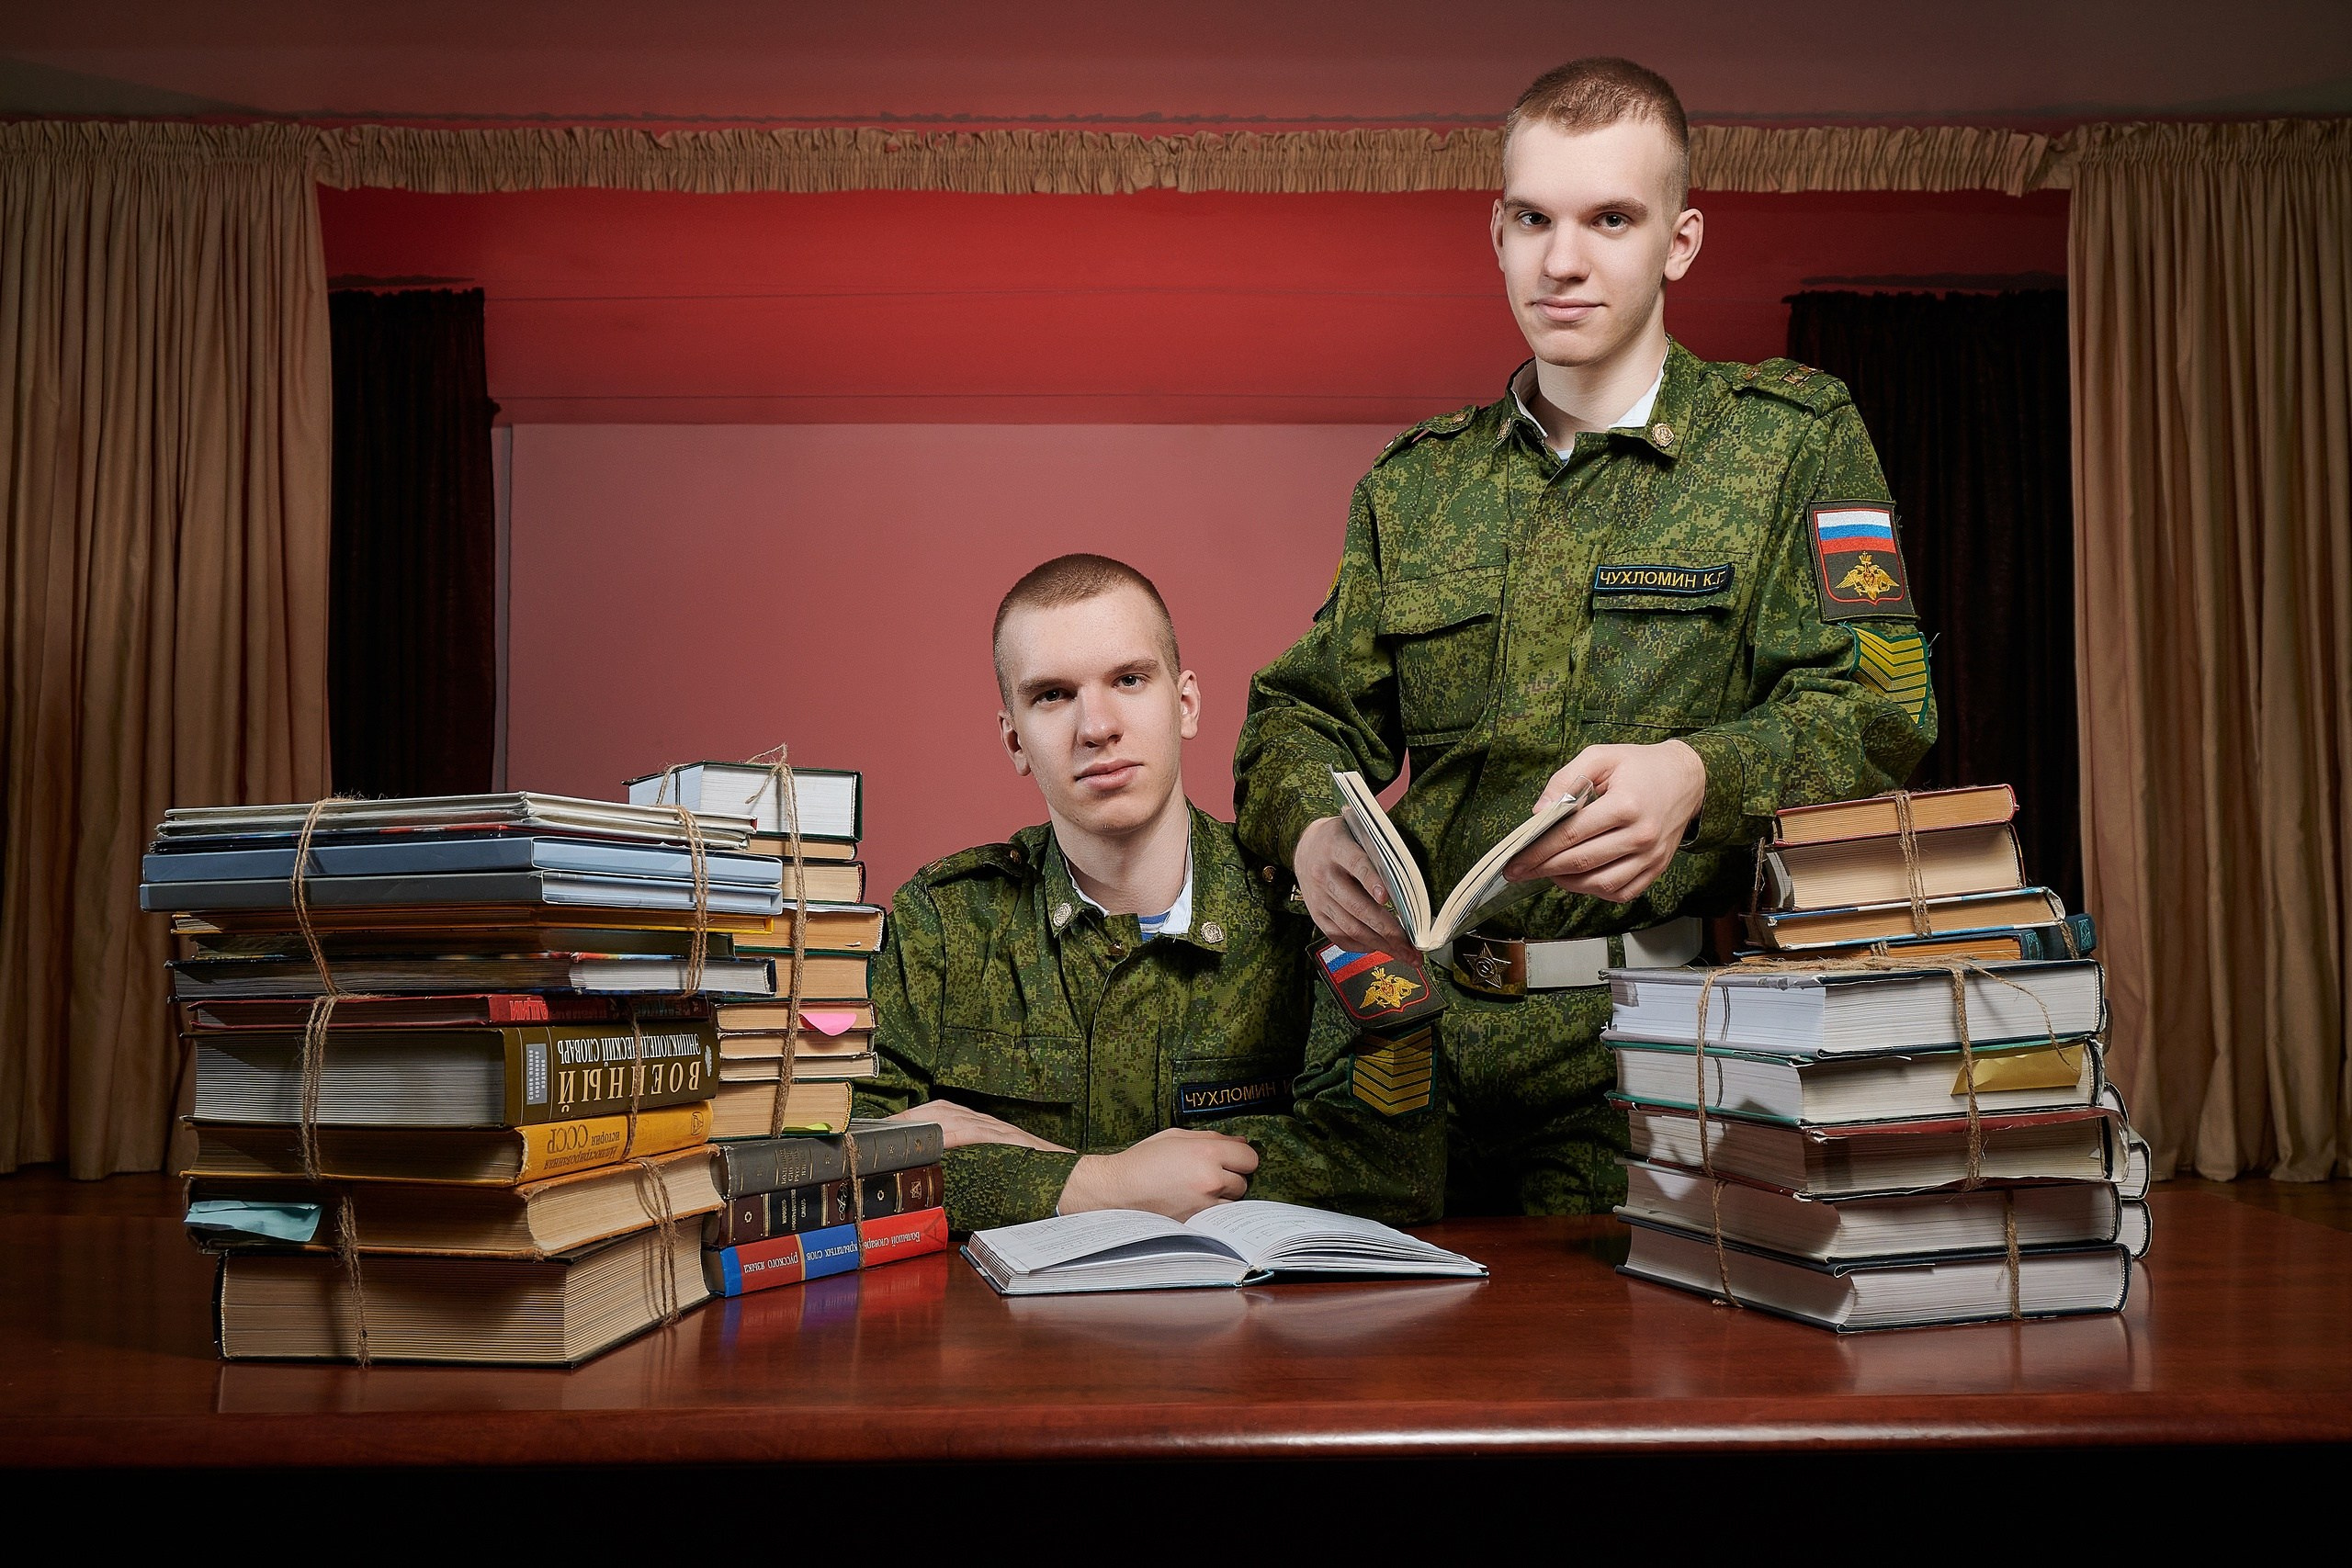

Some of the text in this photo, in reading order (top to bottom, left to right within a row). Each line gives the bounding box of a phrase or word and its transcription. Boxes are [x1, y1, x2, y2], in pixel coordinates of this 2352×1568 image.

[1600, 570, 1697, 589] ЧУХЛОМИН
[557, 1037, 600, 1065] СЛОВАРЬ
[557, 1060, 702, 1113] ВОЕННЫЙ
[1184, 1081, 1277, 1109] ЧУХЛОМИН
[547, 1123, 620, 1155] история СССР
[742, 1230, 921, 1274] Большой словарь крылатых слов русского языка
